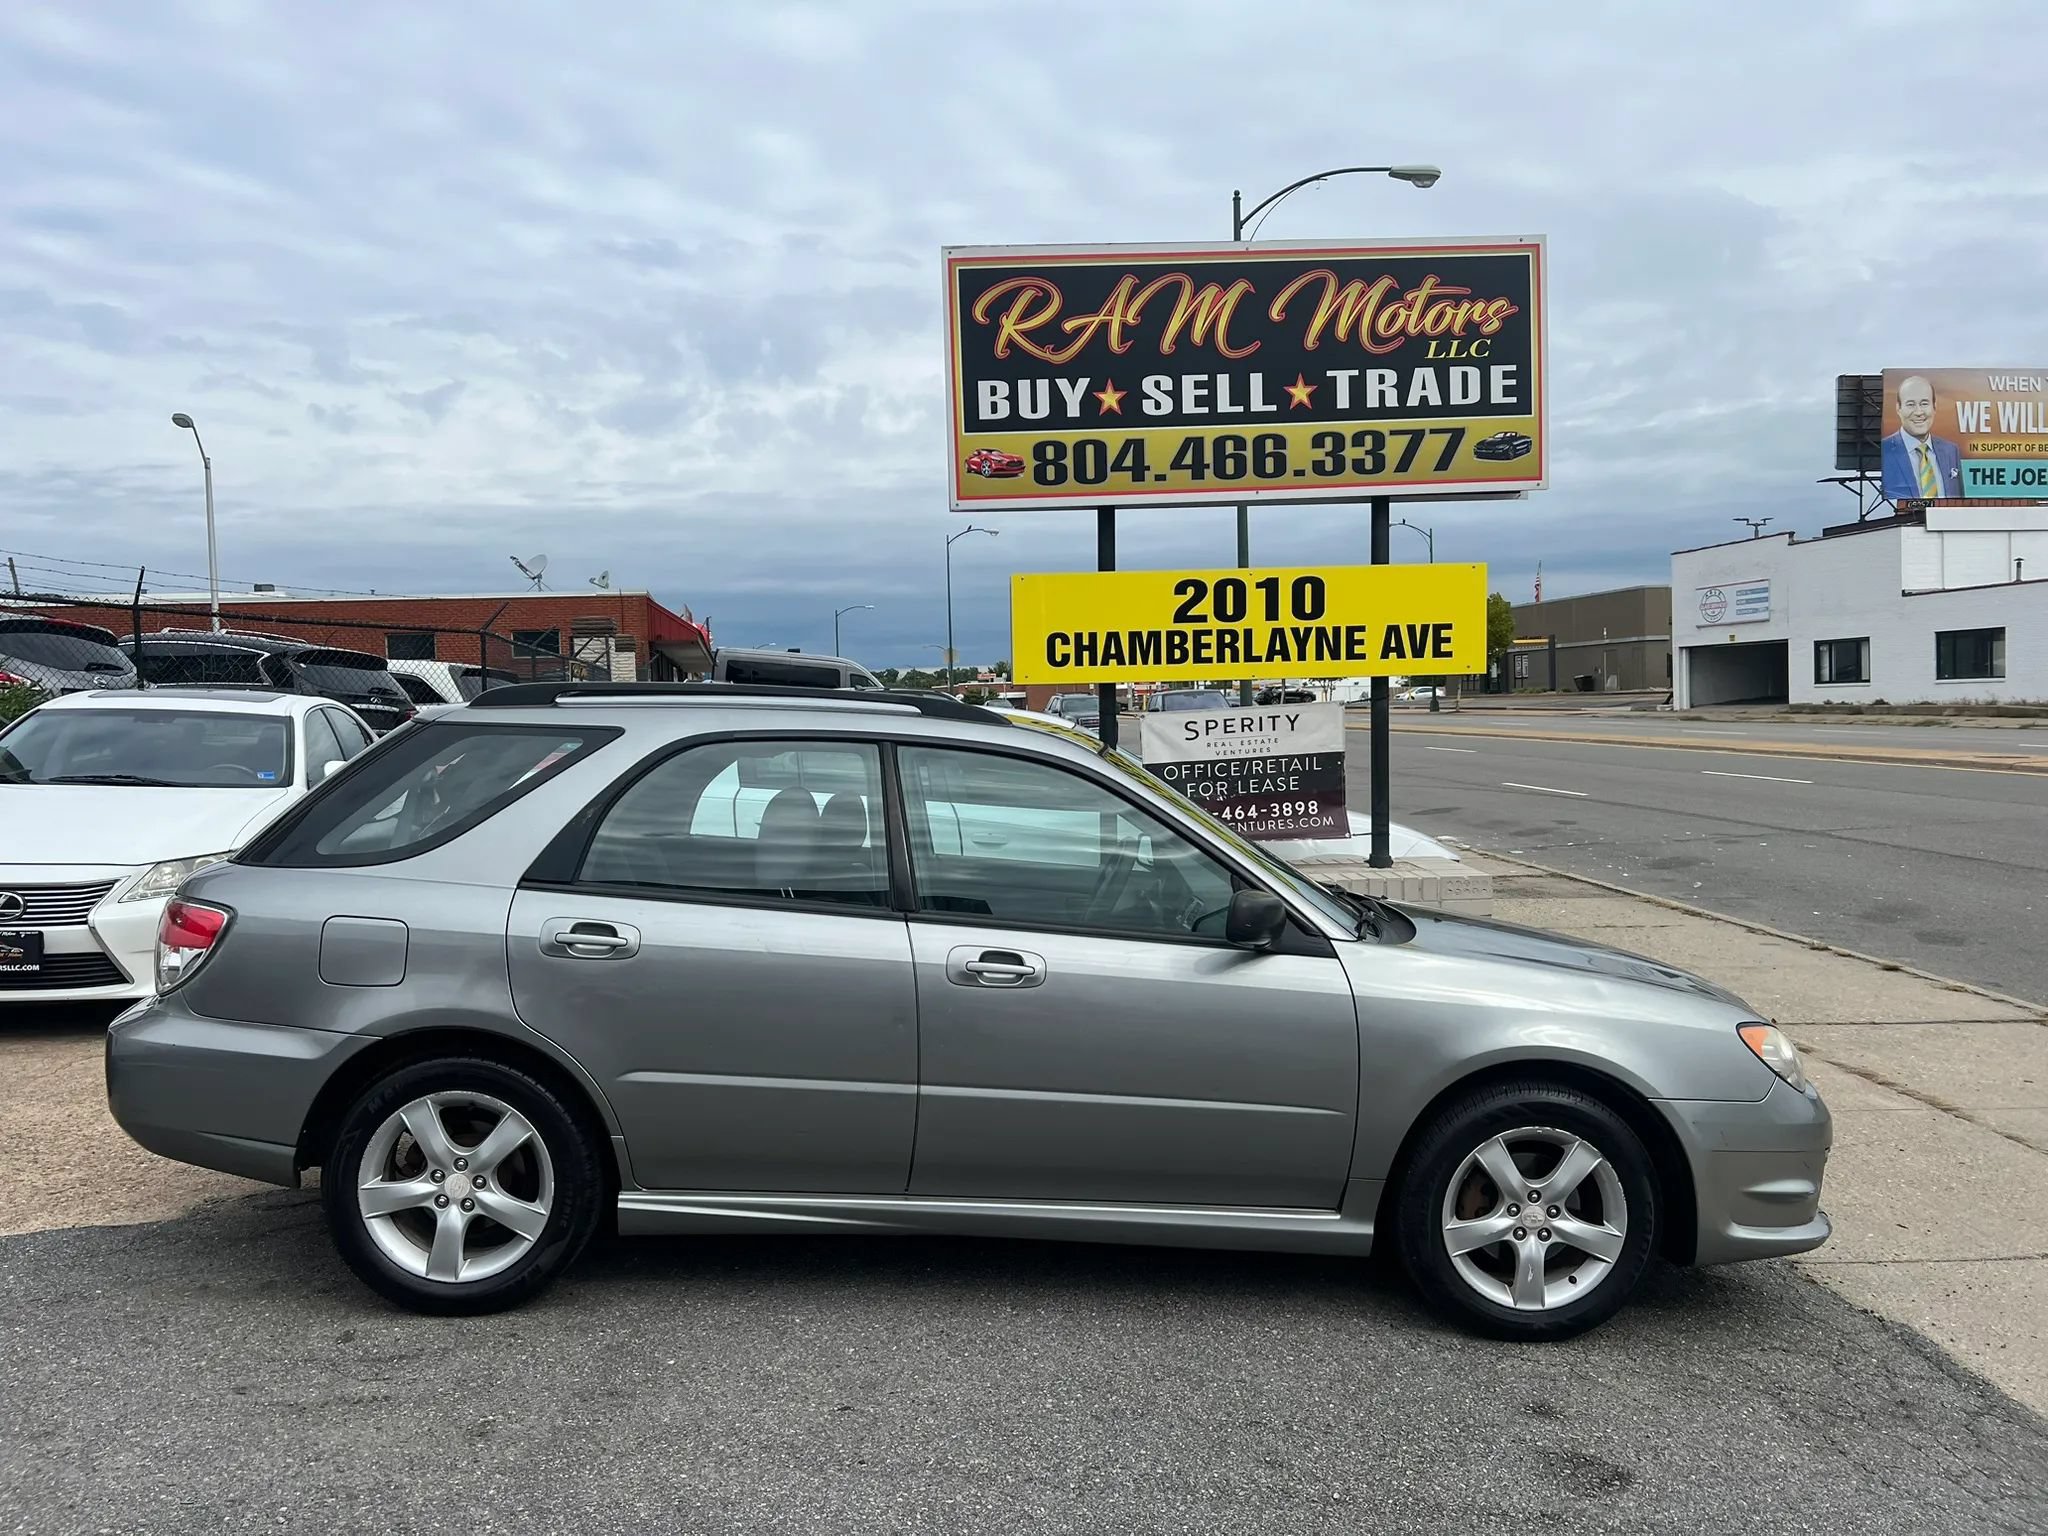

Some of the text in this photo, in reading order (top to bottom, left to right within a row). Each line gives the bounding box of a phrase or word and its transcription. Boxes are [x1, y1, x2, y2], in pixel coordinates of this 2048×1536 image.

[971, 268, 1520, 364] RAM Motors
[1424, 338, 1492, 360] LLC
[977, 364, 1519, 420] BUY SELL TRADE
[1988, 375, 2041, 391] WHEN
[1955, 401, 2048, 433] WE WILL
[1032, 426, 1467, 487] 804.466.3377
[1969, 443, 1979, 452] IN
[1981, 443, 2022, 452] SUPPORT
[2024, 443, 2036, 452] OF
[1969, 467, 2048, 486] THE JOE
[1172, 575, 1326, 624] 2010
[1046, 623, 1454, 668] CHAMBERLAYNE AVE
[1184, 713, 1300, 741] SPERITY
[1215, 747, 1271, 756] VENTURES
[1240, 737, 1279, 746] ESTATE
[1163, 756, 1323, 780] OFFICE/RETAIL
[1186, 776, 1300, 798] FOR LEASE
[1205, 800, 1319, 821] -464-3898
